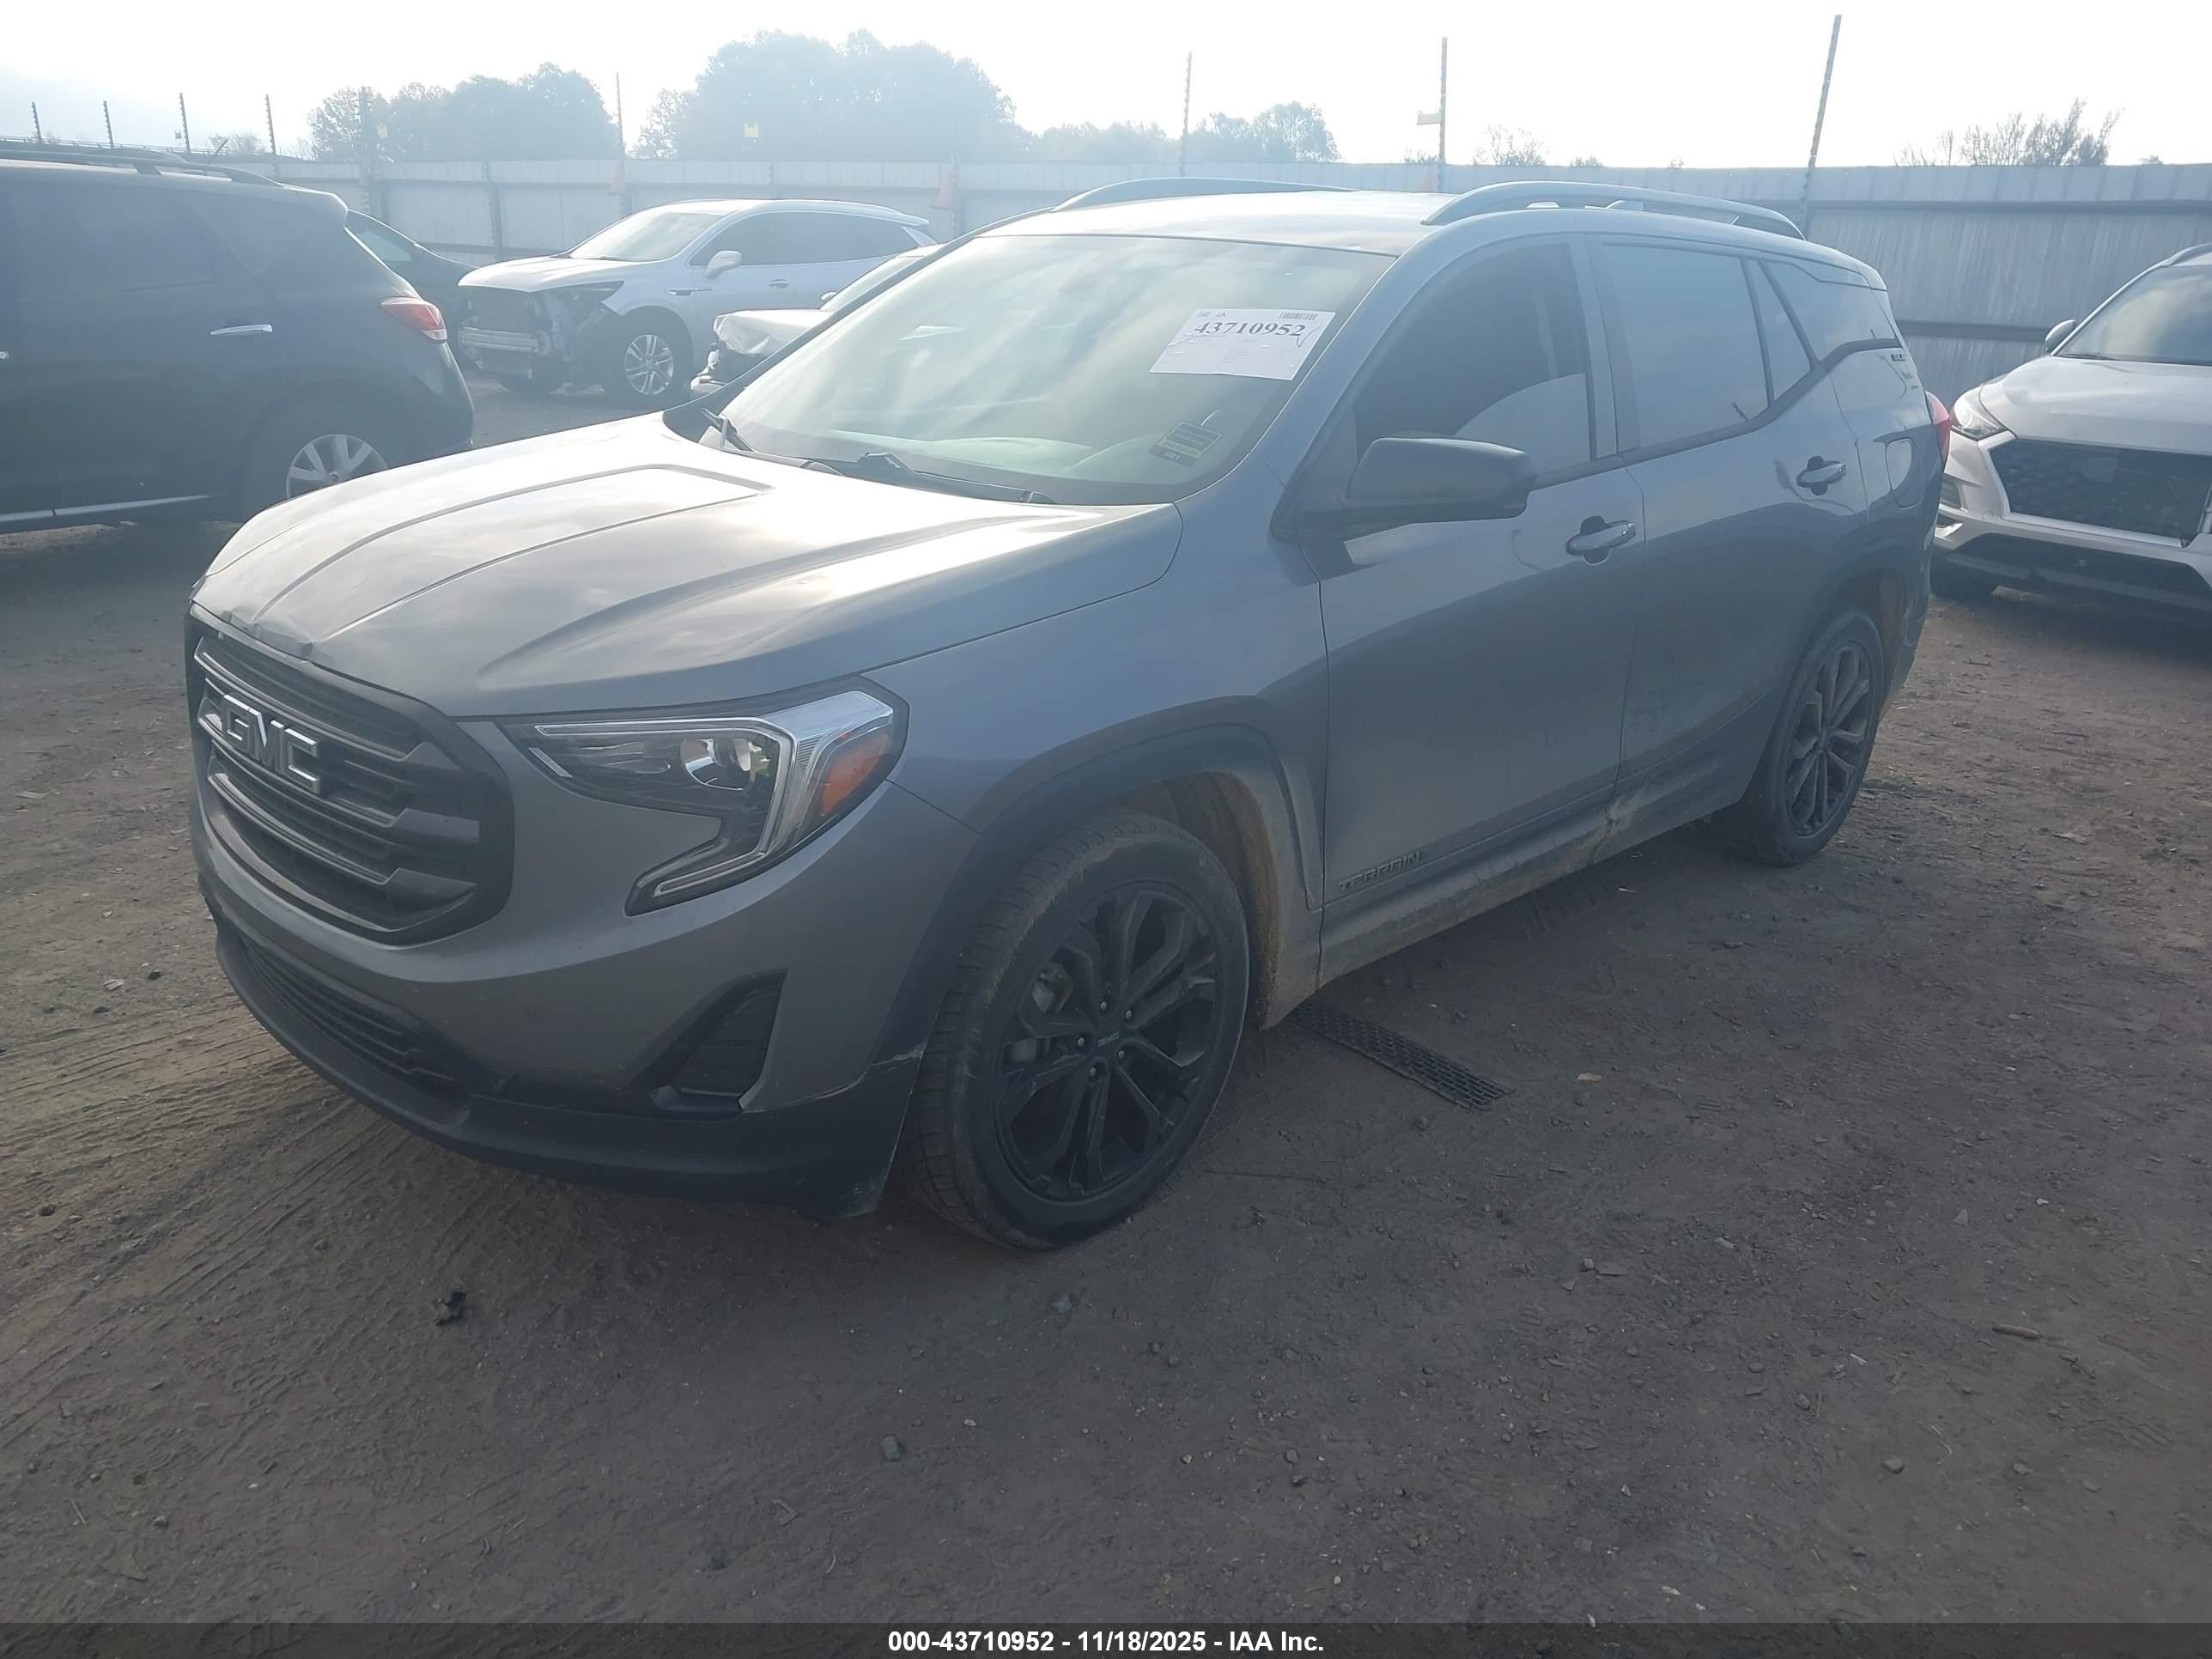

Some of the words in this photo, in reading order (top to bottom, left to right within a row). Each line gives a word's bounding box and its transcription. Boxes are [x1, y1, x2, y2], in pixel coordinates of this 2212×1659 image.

[1194, 321, 1306, 337] 43710952
[222, 694, 321, 794] GMC
[1337, 851, 1421, 892] TERRAIN
